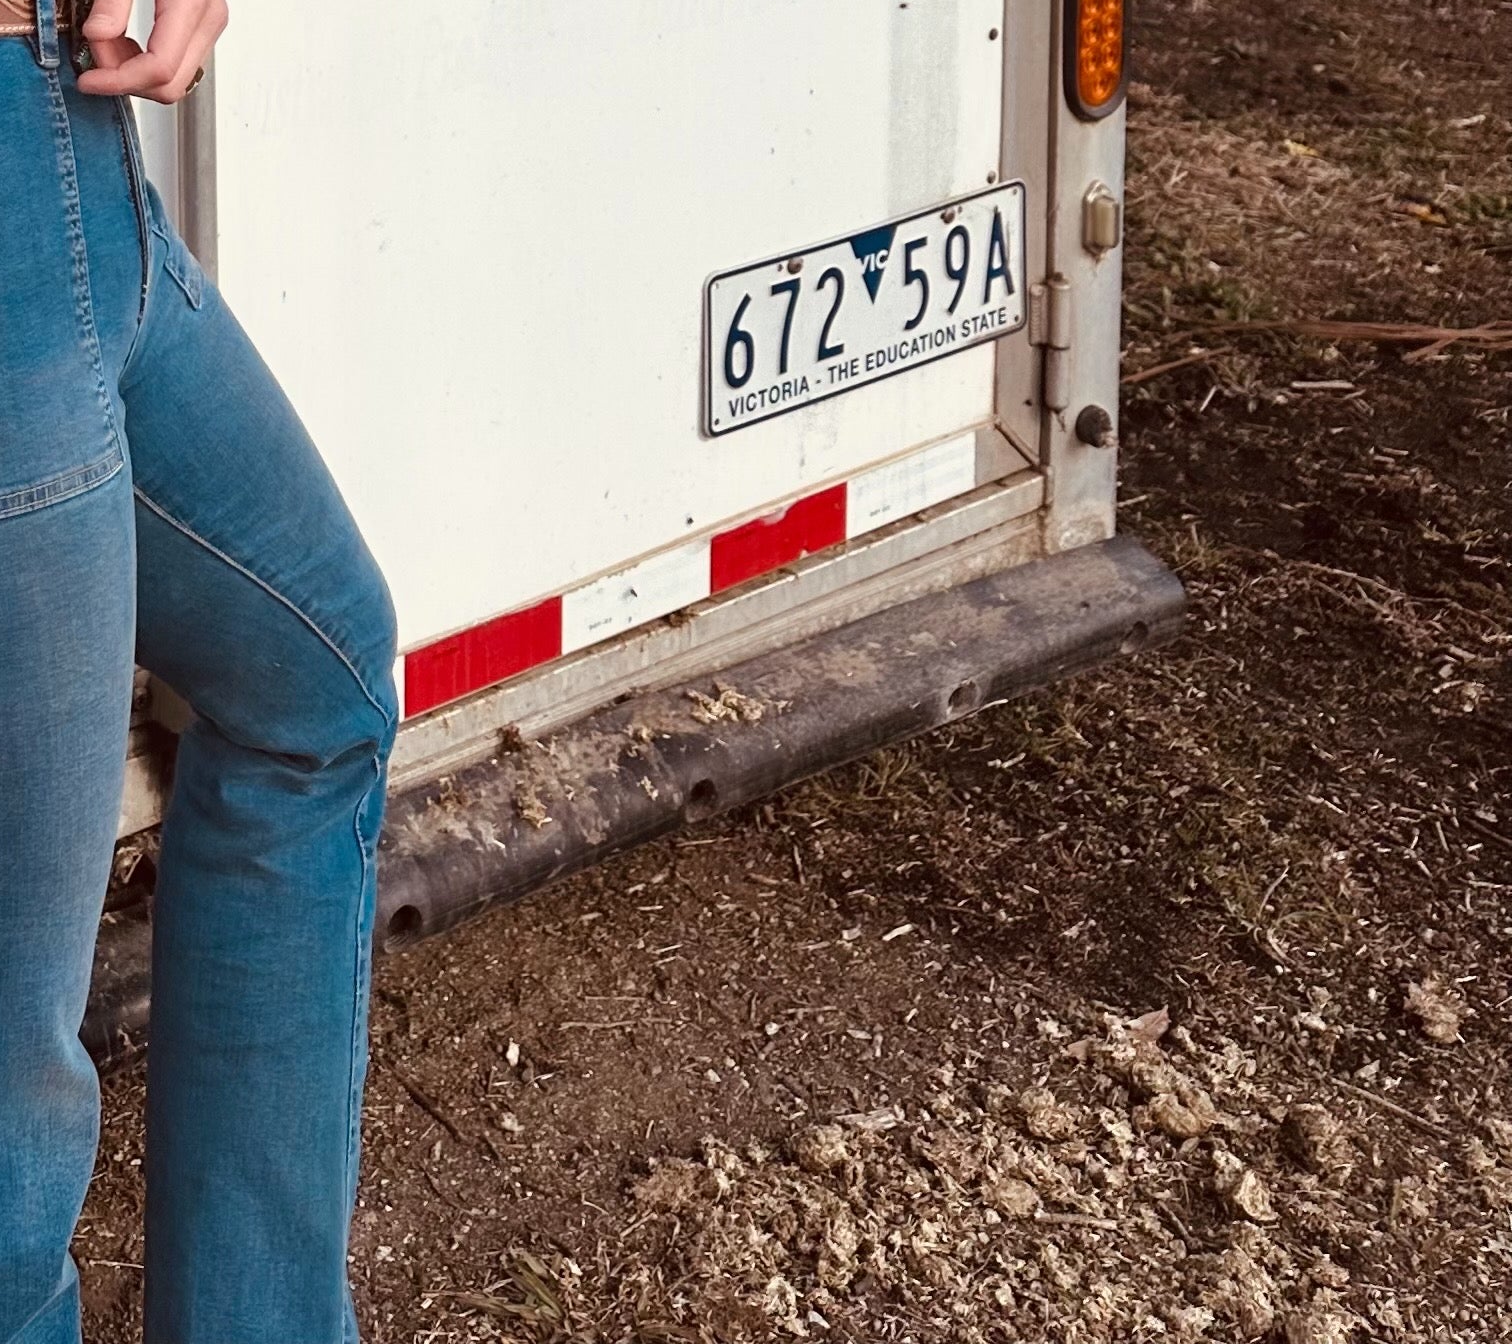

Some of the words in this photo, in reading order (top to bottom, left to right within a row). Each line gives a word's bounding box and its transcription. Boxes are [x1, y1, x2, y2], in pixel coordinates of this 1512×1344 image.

[723, 267, 845, 390] 672
[903, 204, 1016, 331] 59A
[728, 376, 810, 417] VICTORIA
[827, 357, 859, 384] THE
[865, 325, 956, 372] EDUCATION
[961, 306, 1007, 338] STATE
